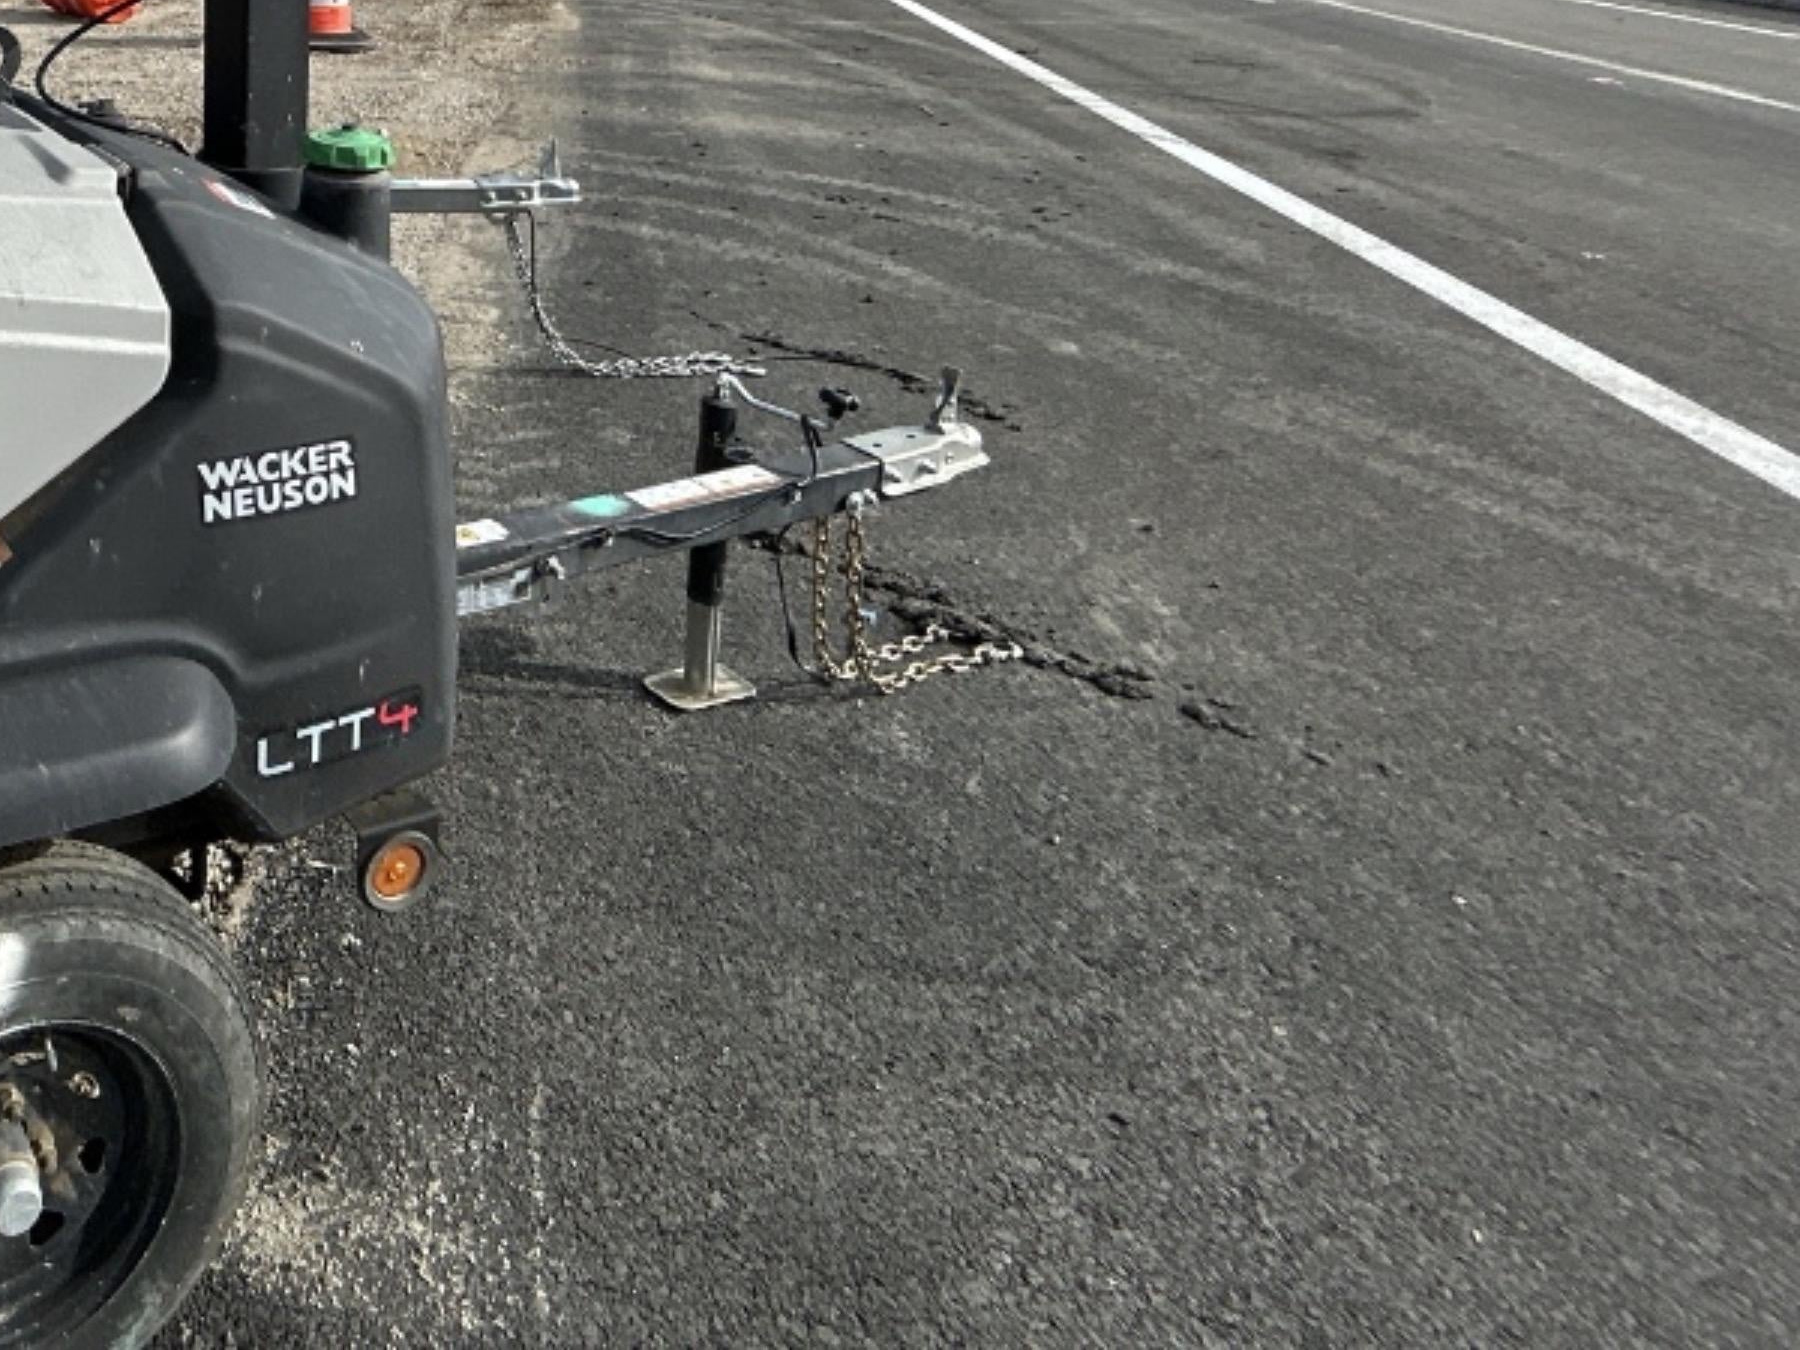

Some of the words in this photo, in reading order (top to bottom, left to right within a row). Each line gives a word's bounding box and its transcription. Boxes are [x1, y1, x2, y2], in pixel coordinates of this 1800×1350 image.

[197, 440, 355, 491] WACKER
[203, 467, 356, 523] NEUSON
[257, 701, 418, 778] LTT4
